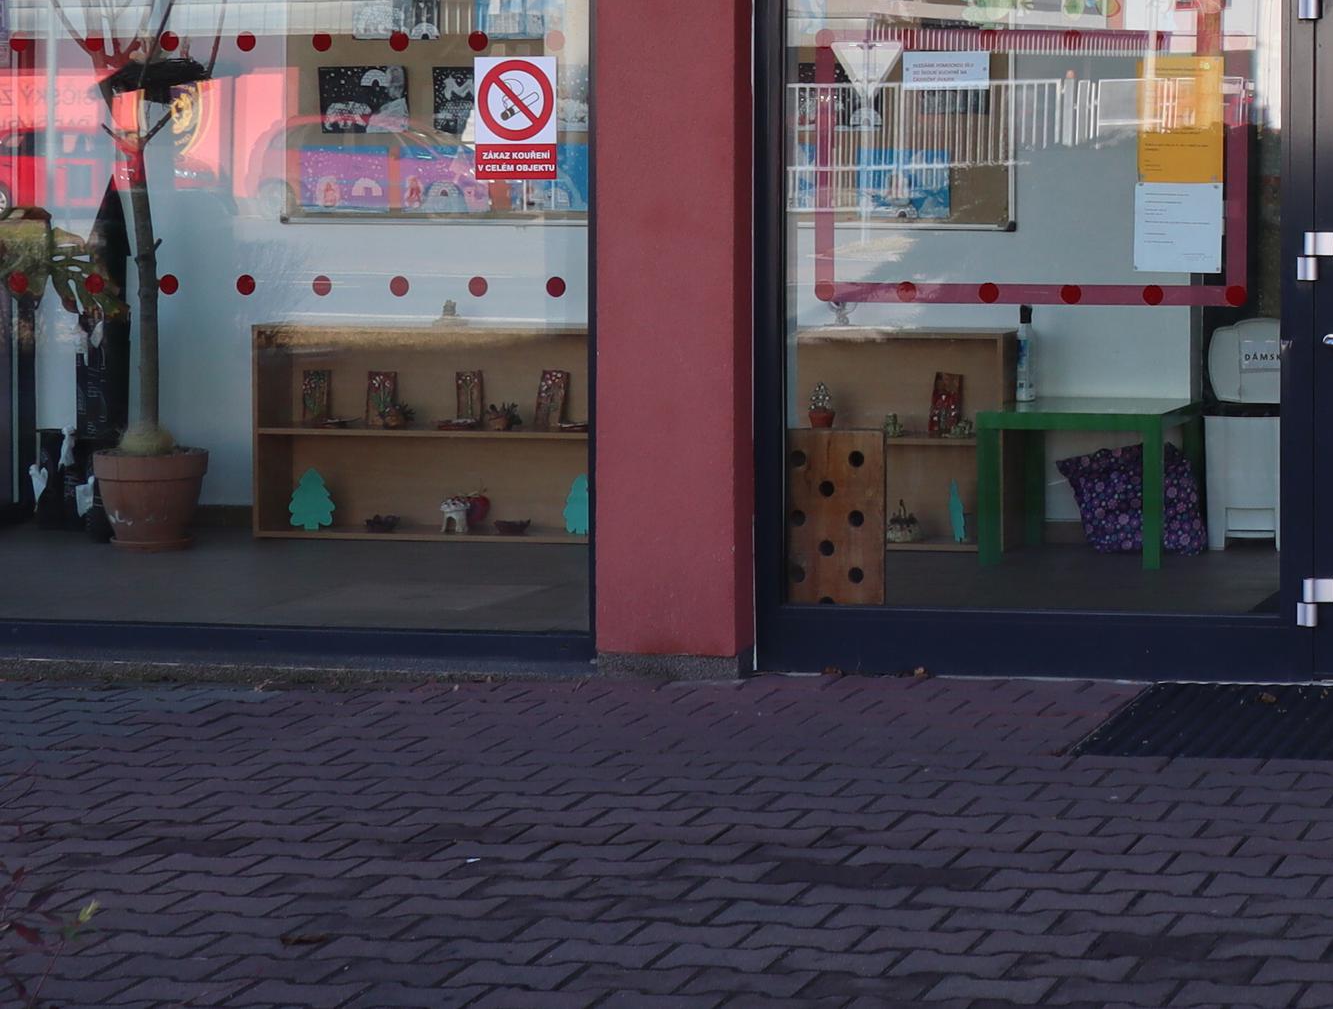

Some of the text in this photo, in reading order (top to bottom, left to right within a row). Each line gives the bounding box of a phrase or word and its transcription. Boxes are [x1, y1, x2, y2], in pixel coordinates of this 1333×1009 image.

[482, 150, 550, 160] ZÁKAZ KOUŘENÍ
[477, 163, 555, 172] V CELÉM OBJEKTU
[1244, 351, 1281, 361] DÁMSK
